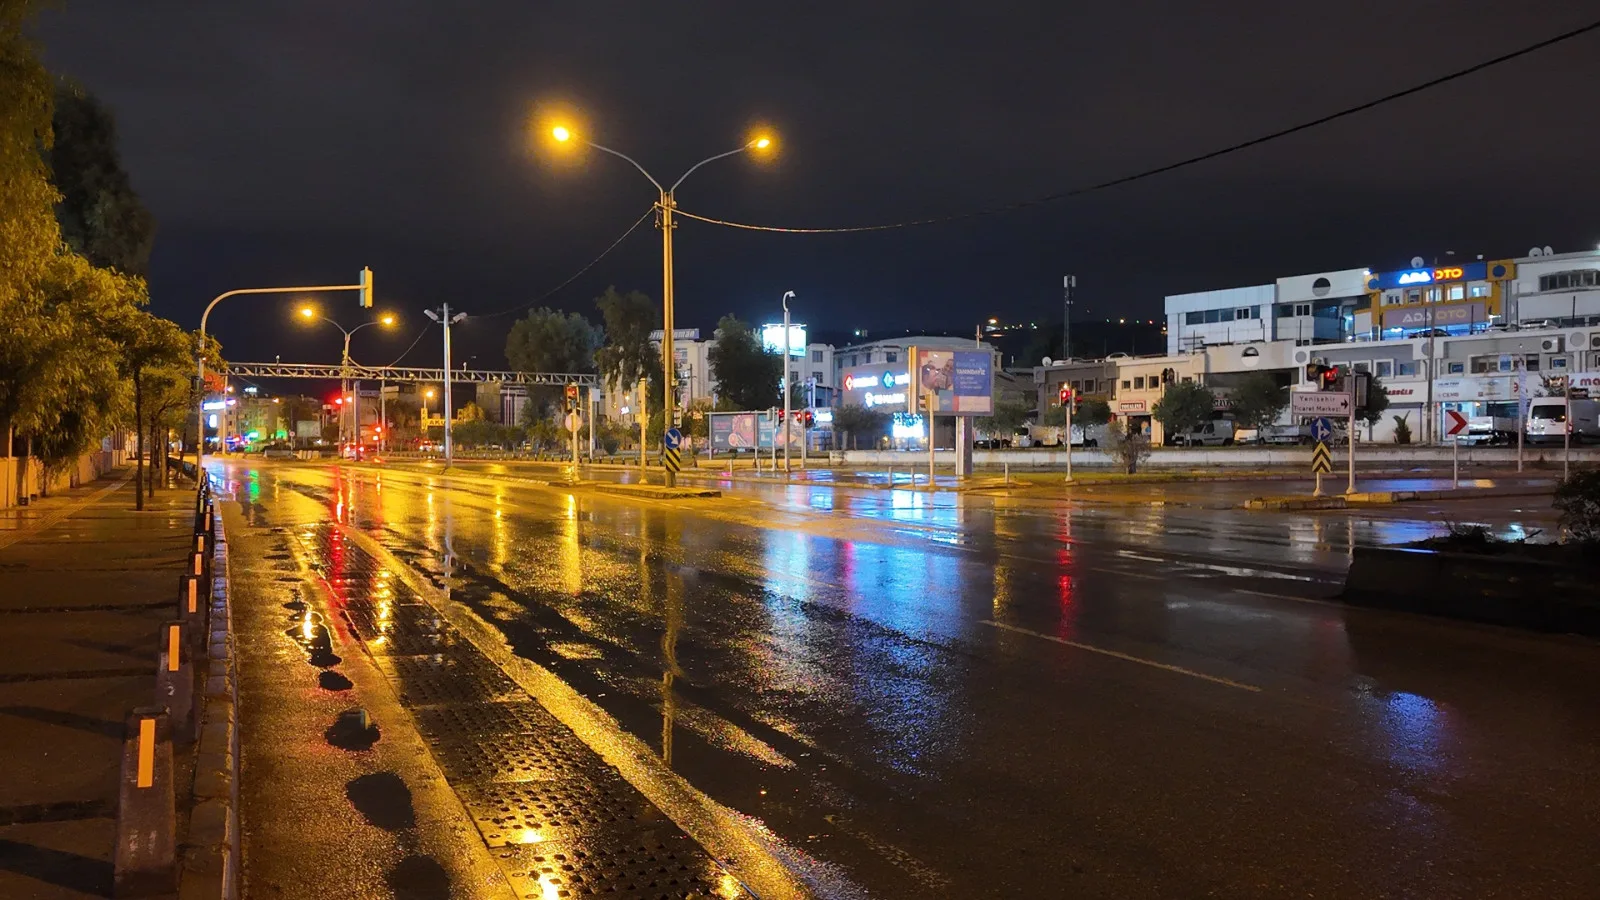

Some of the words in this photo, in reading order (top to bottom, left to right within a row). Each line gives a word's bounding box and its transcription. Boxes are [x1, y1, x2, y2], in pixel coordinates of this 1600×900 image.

[1398, 271, 1431, 285] ADA
[1432, 268, 1463, 280] OTO
[1402, 312, 1433, 323] ADA
[1436, 308, 1467, 320] OTO
